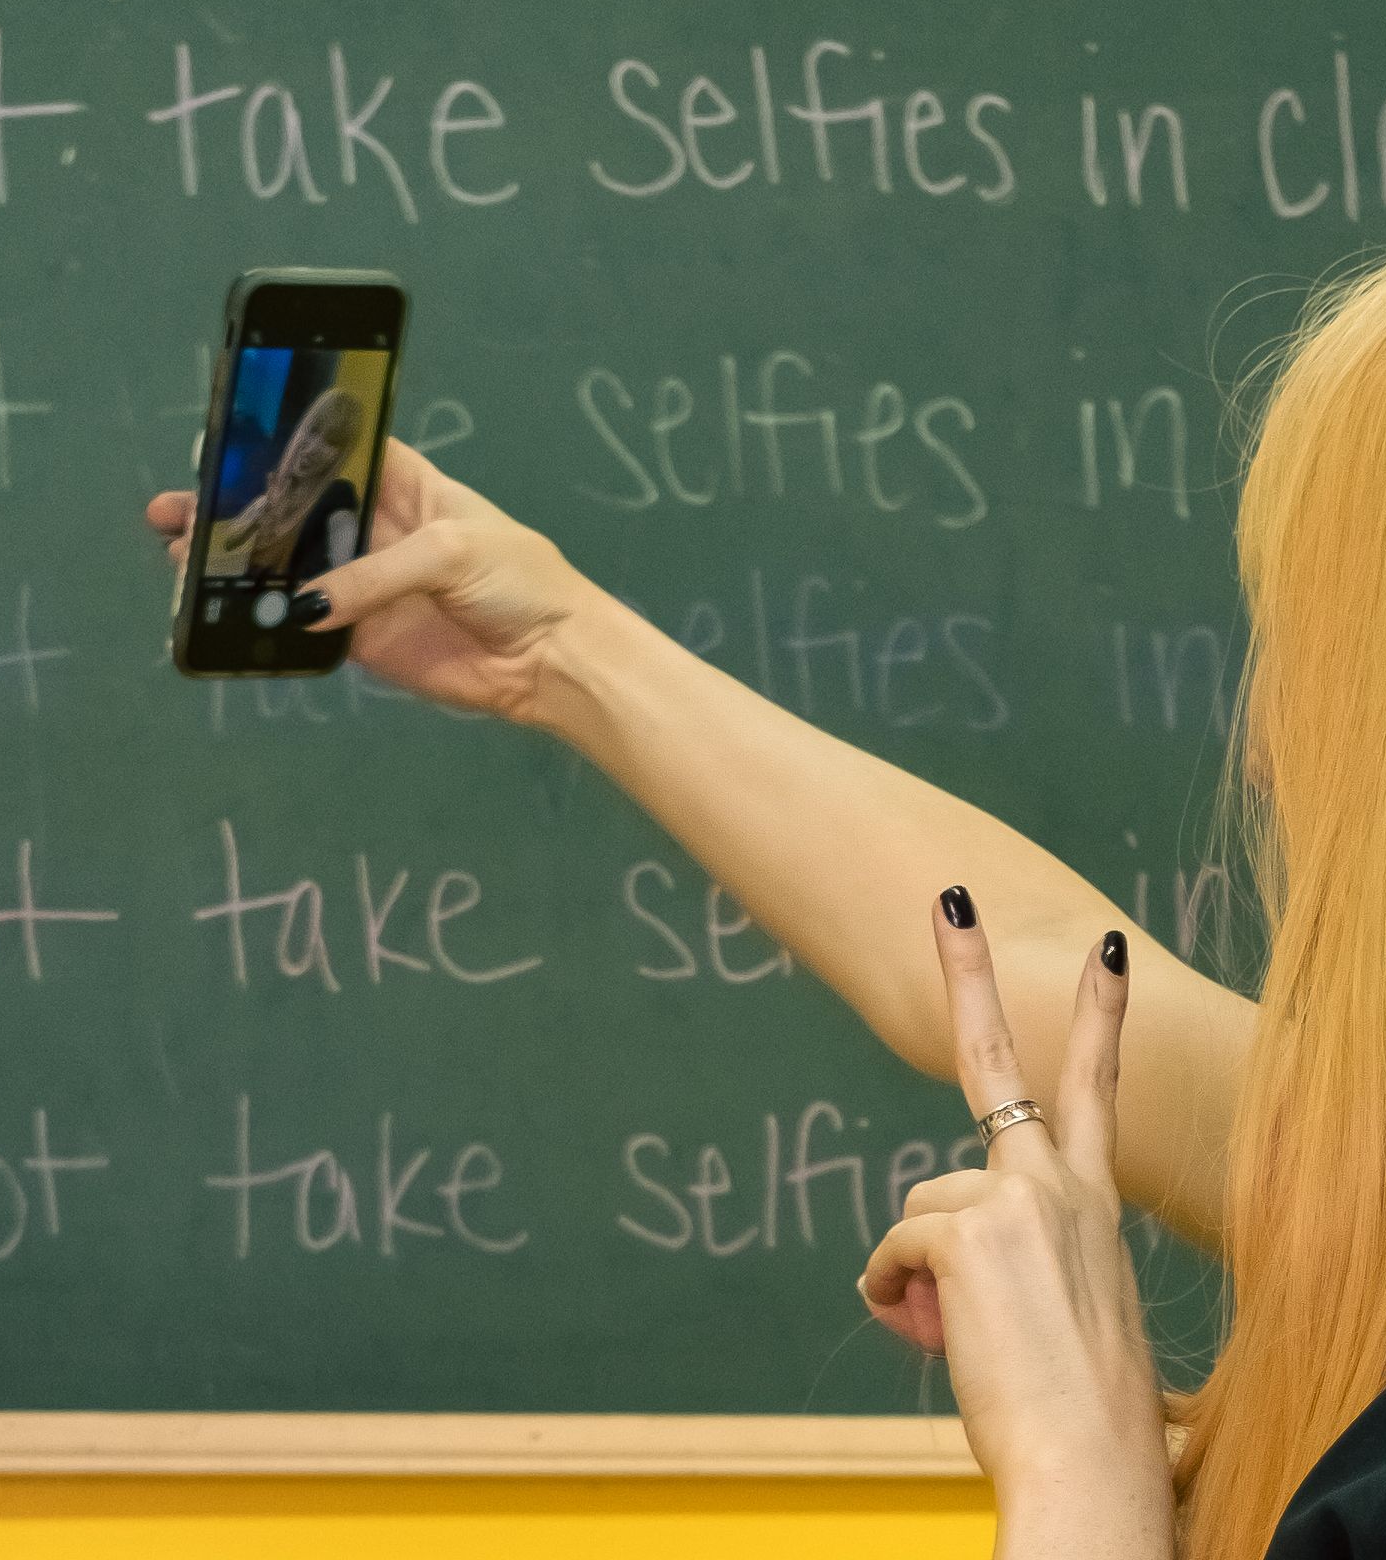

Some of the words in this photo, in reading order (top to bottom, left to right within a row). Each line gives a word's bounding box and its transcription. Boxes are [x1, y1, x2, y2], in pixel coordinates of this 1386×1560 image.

[144, 40, 520, 225] take
[589, 40, 1015, 201] selfies
[1081, 42, 1189, 211] in
[577, 348, 990, 529] selfies
[1068, 345, 1195, 522] in
[616, 565, 1009, 732] elfies
[1097, 581, 1226, 737] in
[194, 818, 545, 994] take
[206, 1095, 531, 1258] take
